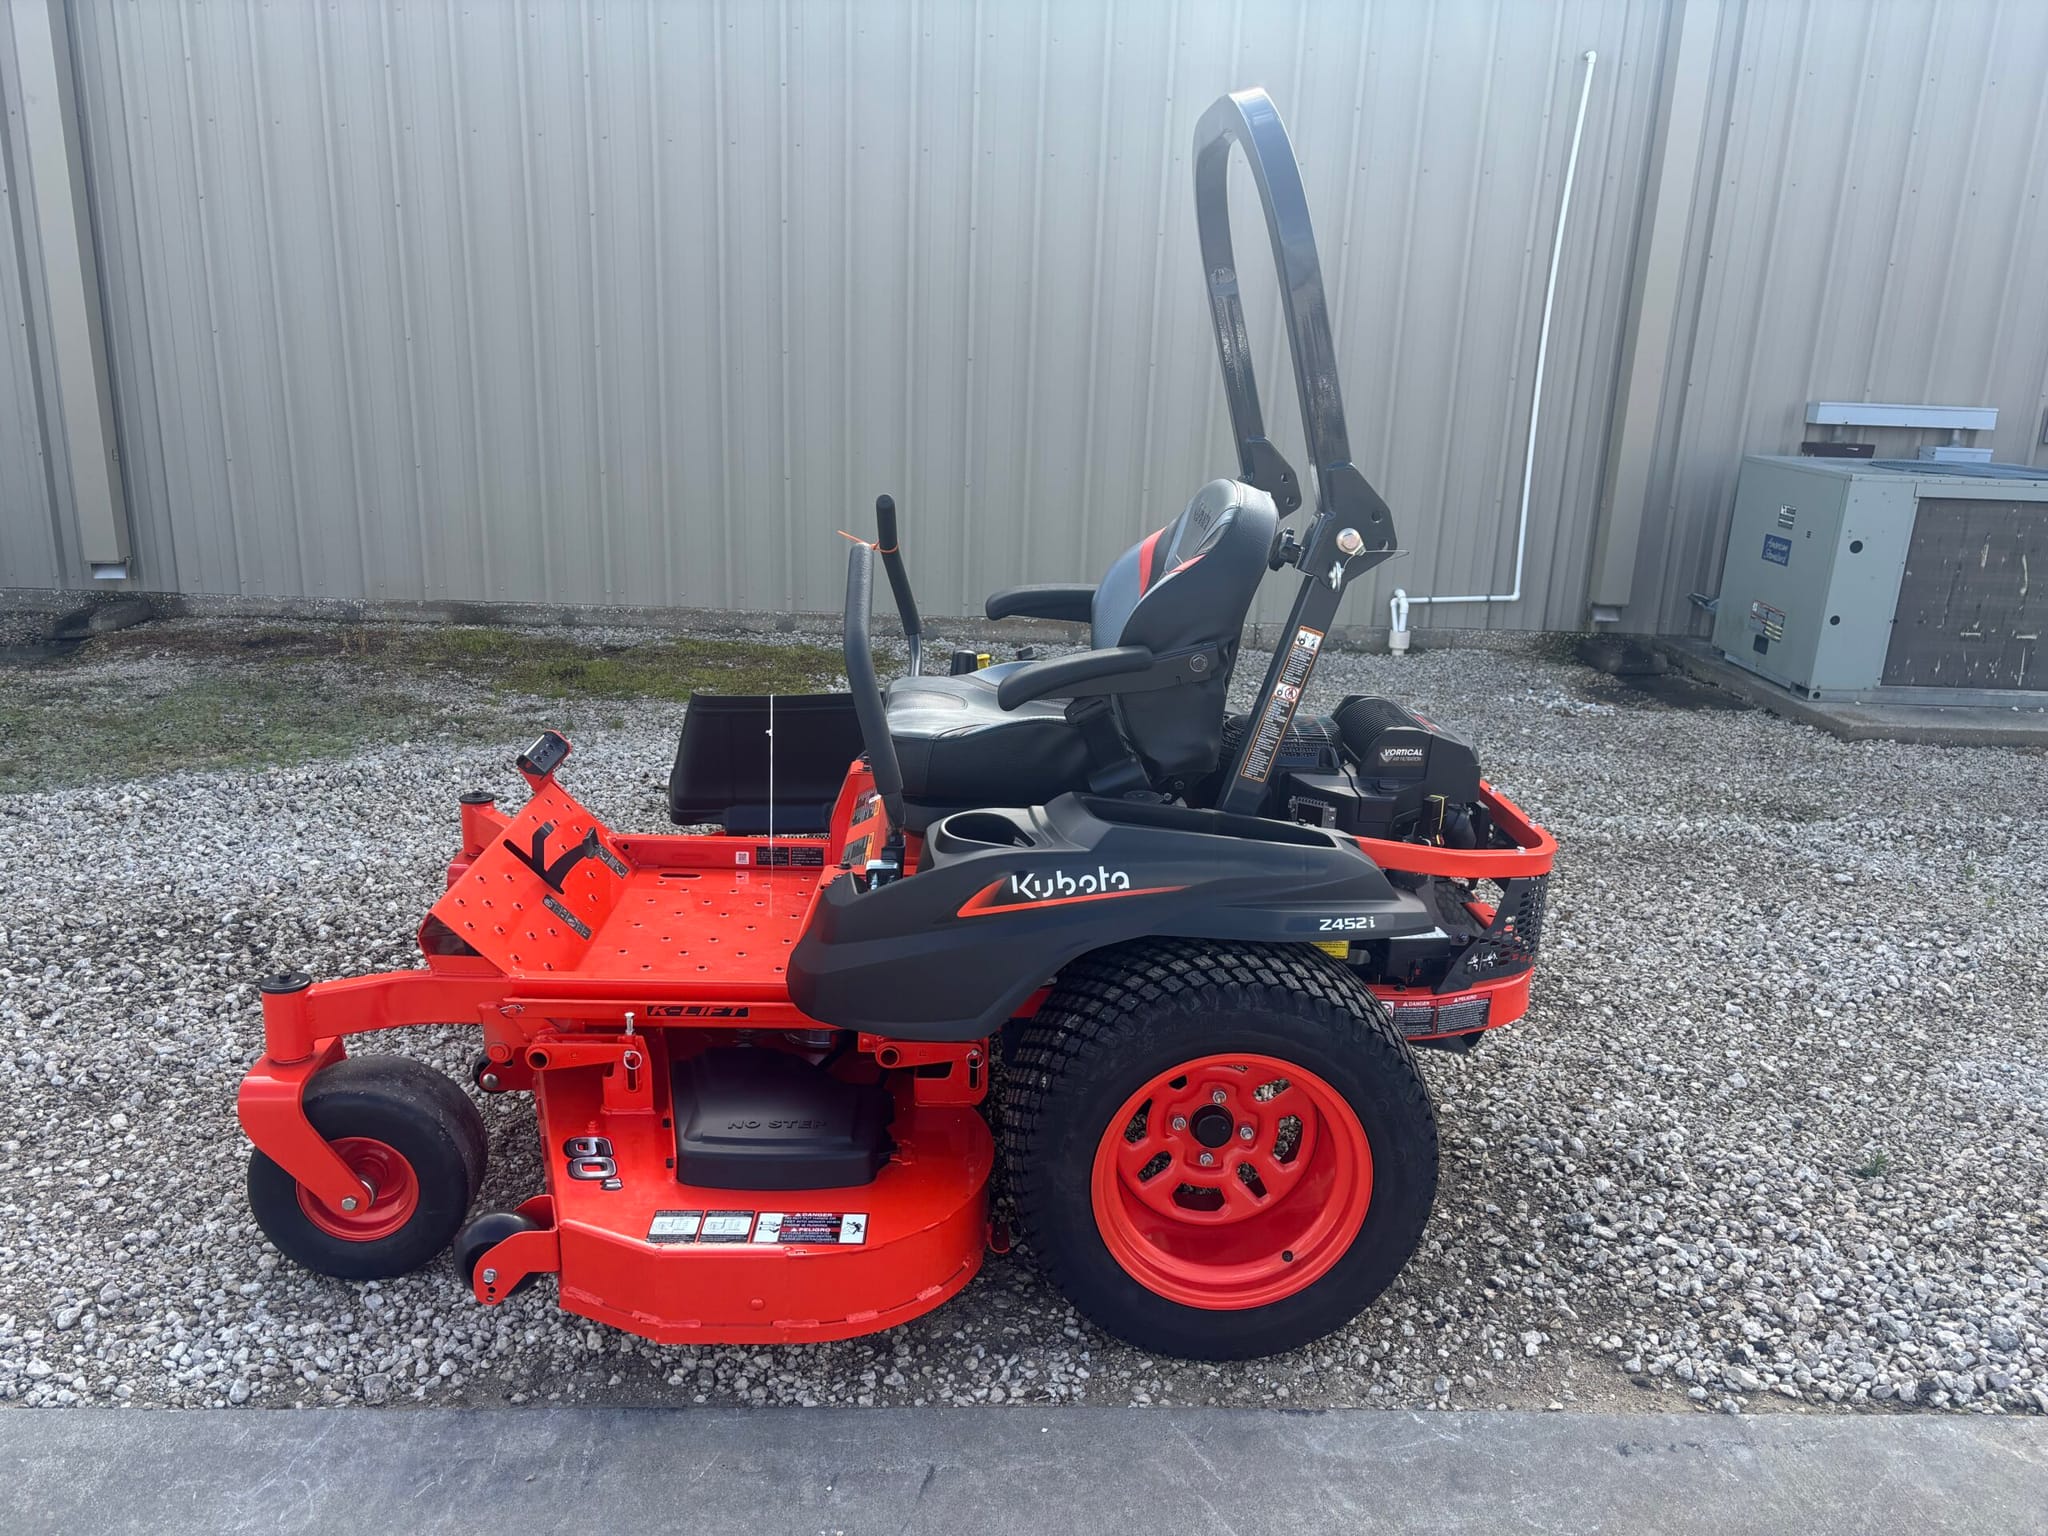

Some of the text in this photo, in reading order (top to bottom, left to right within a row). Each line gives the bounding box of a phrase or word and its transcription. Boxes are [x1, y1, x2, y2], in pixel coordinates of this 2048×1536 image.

[1384, 748, 1424, 756] VORTICAL
[1011, 866, 1130, 899] Kubota
[1319, 916, 1376, 931] Z452i
[649, 1006, 745, 1016] K-LIFT
[727, 1119, 828, 1130] NO STEP
